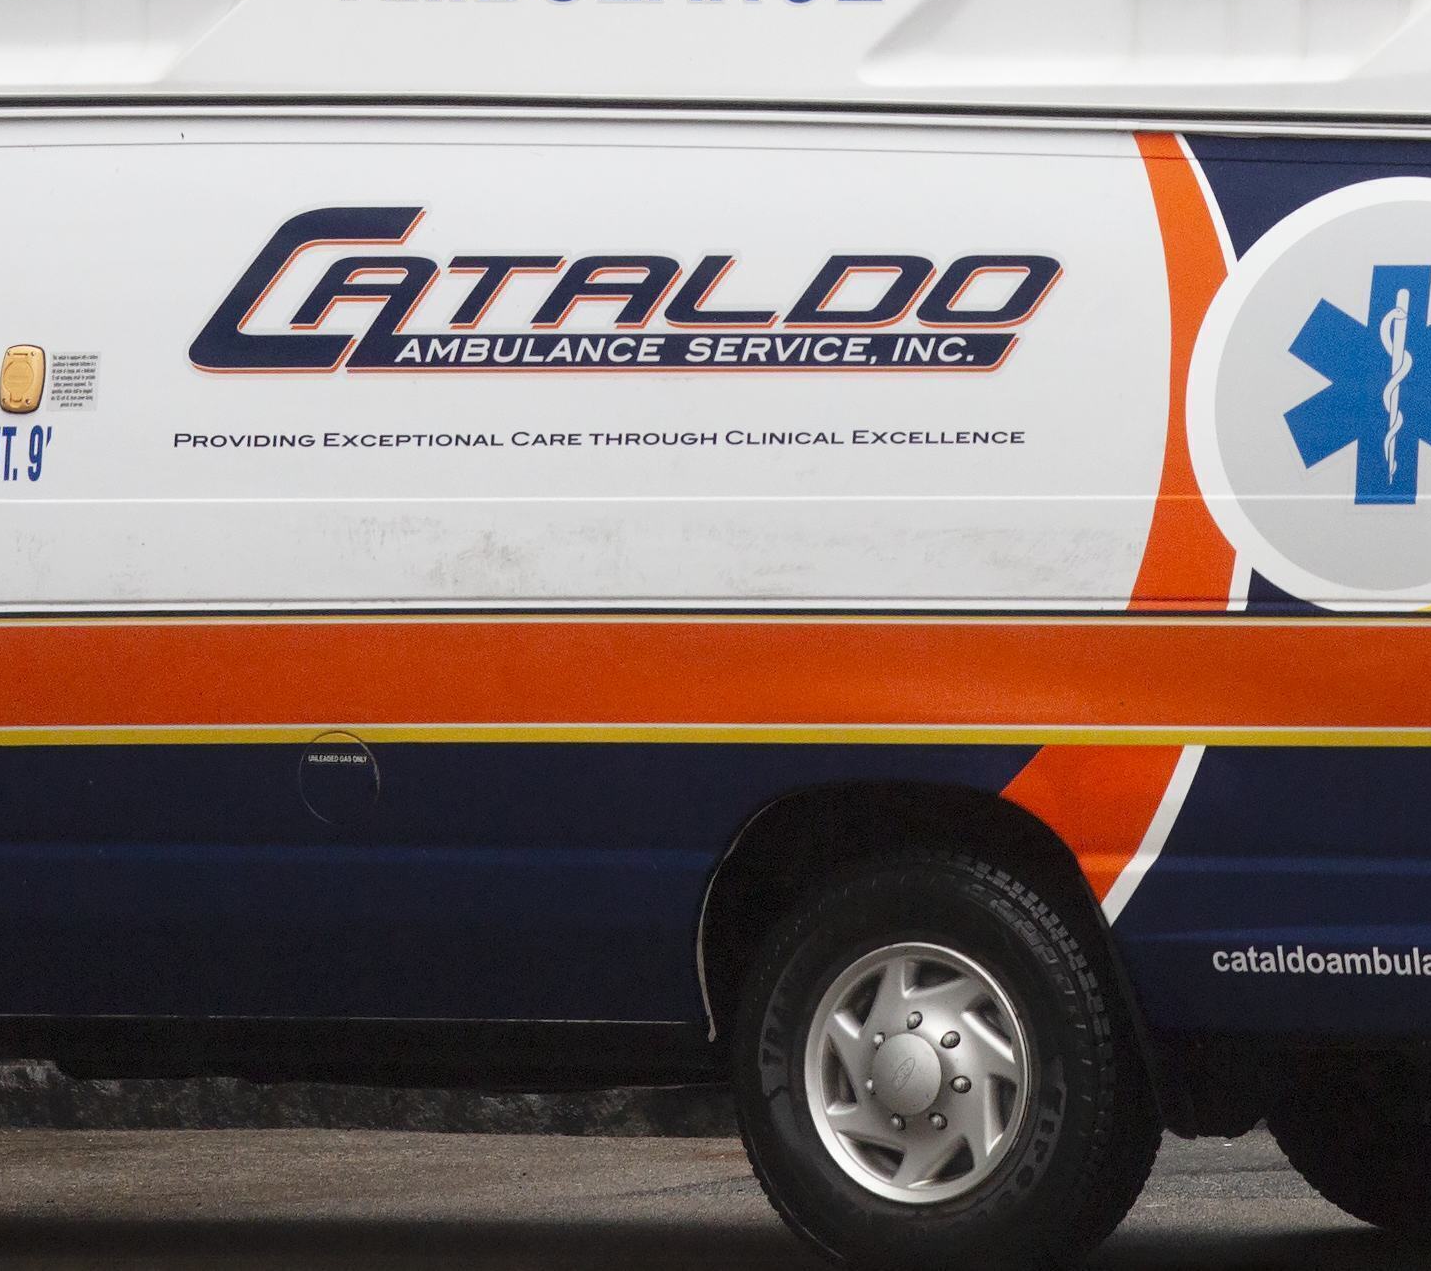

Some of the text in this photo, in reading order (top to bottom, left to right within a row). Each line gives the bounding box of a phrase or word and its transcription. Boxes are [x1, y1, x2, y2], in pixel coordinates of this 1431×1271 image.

[188, 206, 1064, 374] CATALDO
[395, 336, 976, 366] AMBULANCE SERVICE, INC.
[27, 424, 52, 483] 9'
[173, 429, 1026, 448] PROVIDING EXCEPTIONAL CARE THROUGH CLINICAL EXCELLENCE
[308, 754, 368, 763] UNLEADED GAS ONLY
